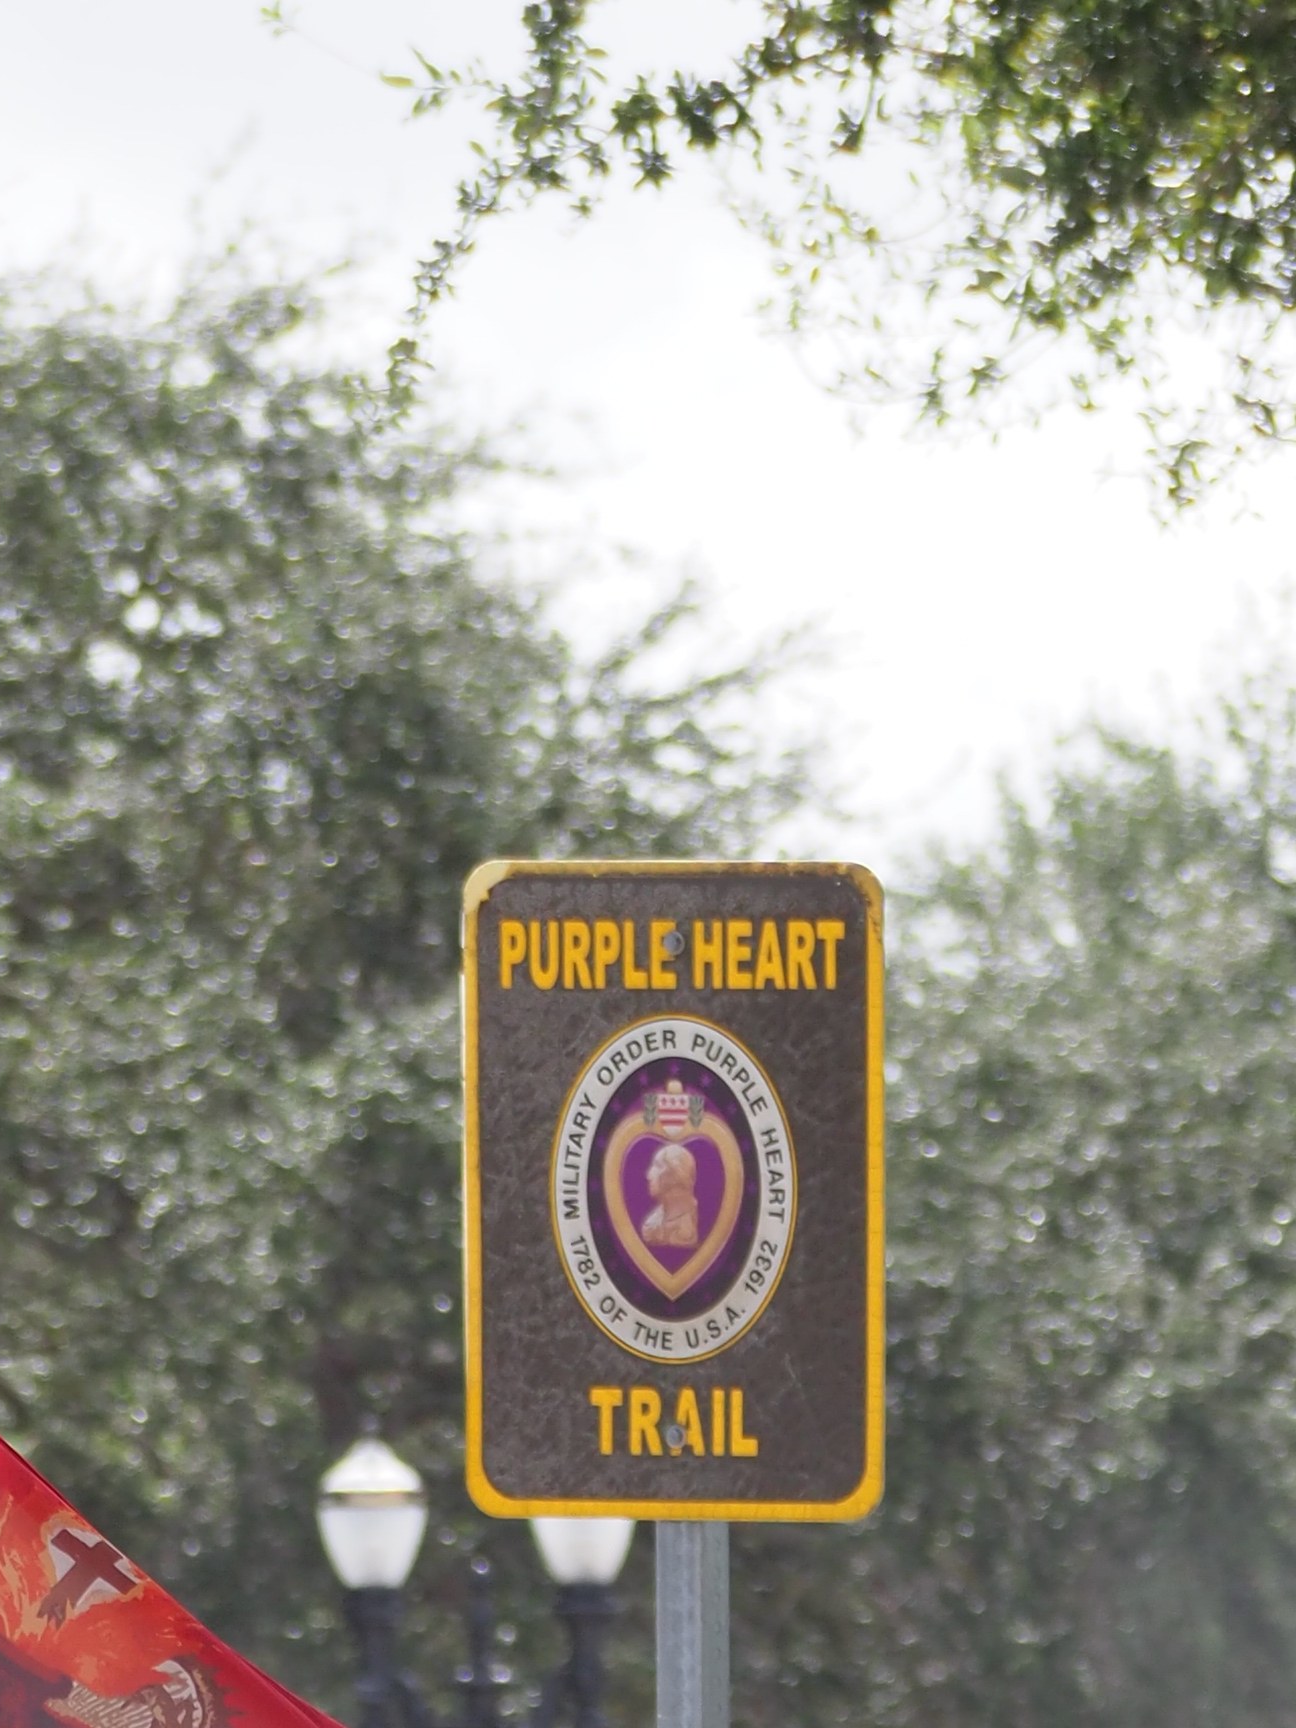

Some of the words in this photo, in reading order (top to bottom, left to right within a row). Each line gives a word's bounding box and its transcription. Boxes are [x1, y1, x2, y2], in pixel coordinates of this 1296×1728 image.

[499, 918, 678, 990] PURPLE
[692, 918, 846, 990] HEART
[562, 1092, 598, 1220] MILITARY
[597, 1029, 677, 1086] ORDER
[691, 1033, 768, 1117] PURPLE
[760, 1127, 786, 1224] HEART
[570, 1235, 601, 1291] 1782
[599, 1295, 628, 1325] OF
[632, 1321, 673, 1350] THE
[685, 1305, 746, 1349] U.S.A.
[744, 1239, 778, 1295] 1932
[588, 1385, 760, 1457] TRAIL
